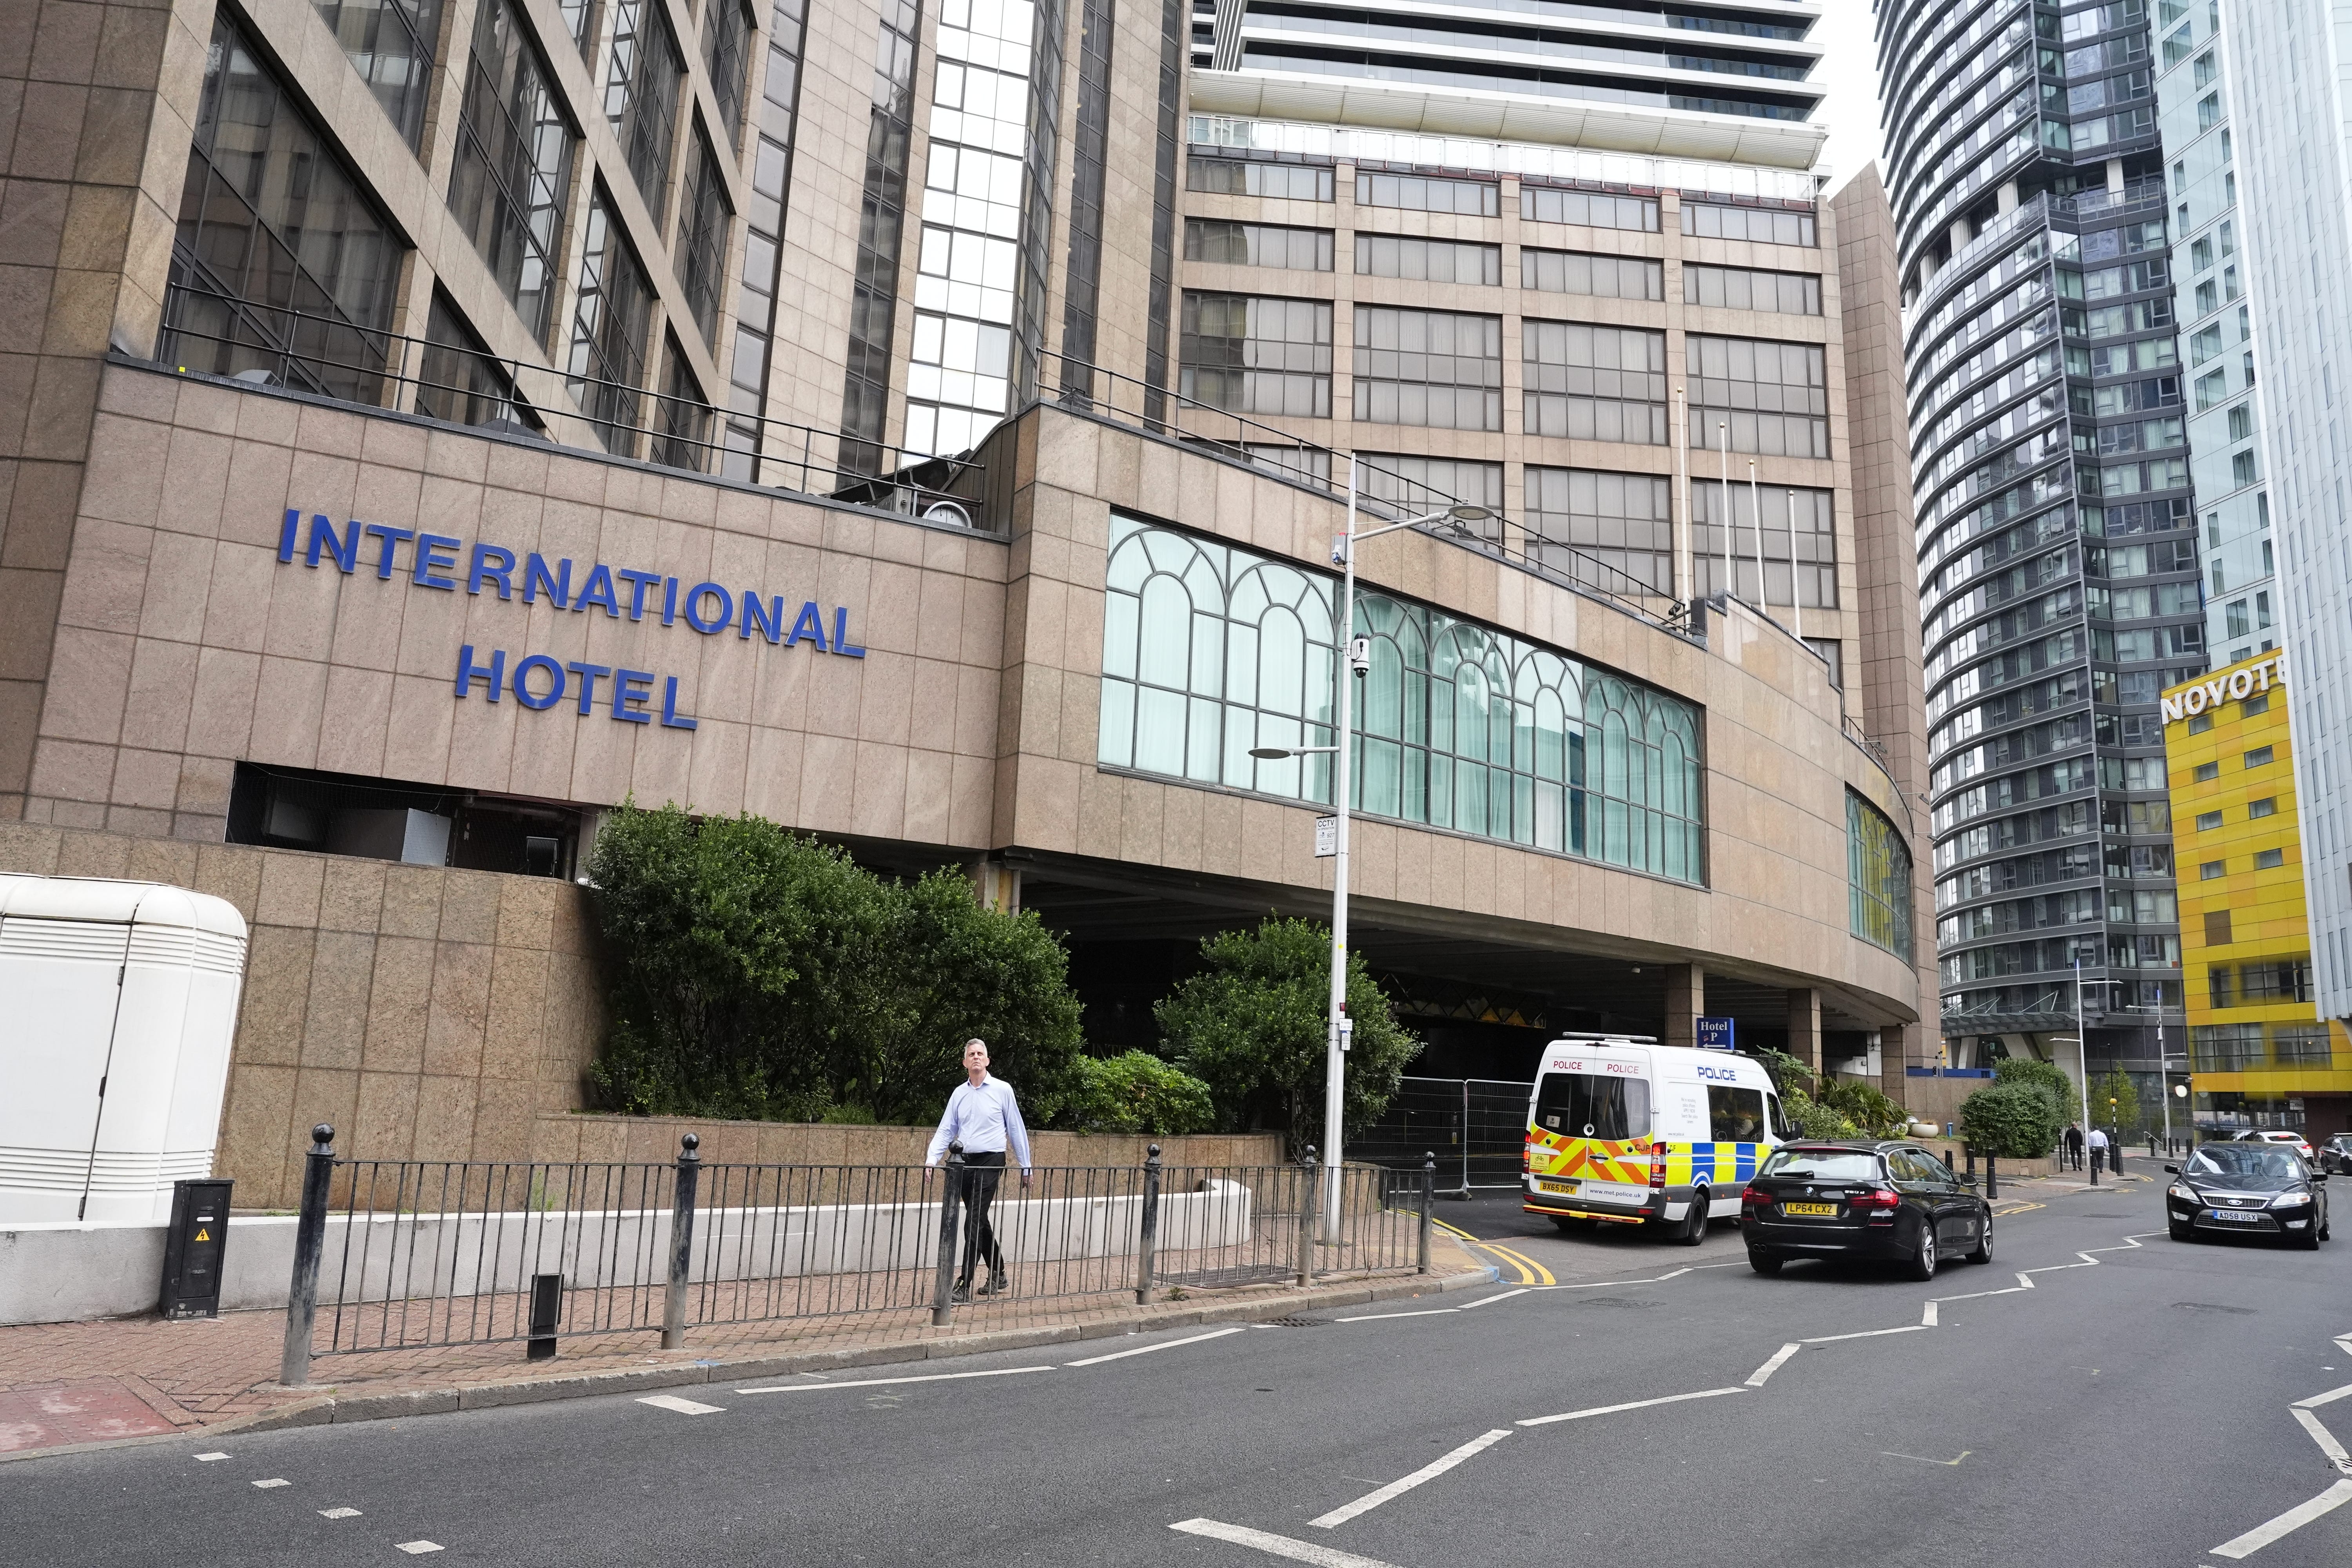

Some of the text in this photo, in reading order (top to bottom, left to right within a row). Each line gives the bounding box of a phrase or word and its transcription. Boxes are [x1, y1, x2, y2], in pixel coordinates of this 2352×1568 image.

[279, 509, 866, 658] INTERNATIONAL
[456, 645, 697, 729] HOTEL
[1700, 1021, 1728, 1031] Hotel
[1710, 1032, 1718, 1042] P
[1553, 1060, 1582, 1071] POLICE
[1607, 1063, 1639, 1074] POLICE
[1697, 1066, 1737, 1082] POLICE
[1542, 1183, 1574, 1193] BX65 DSY
[1590, 1189, 1641, 1198] www.met.police.uk
[1790, 1204, 1833, 1213] LP64 CXZ
